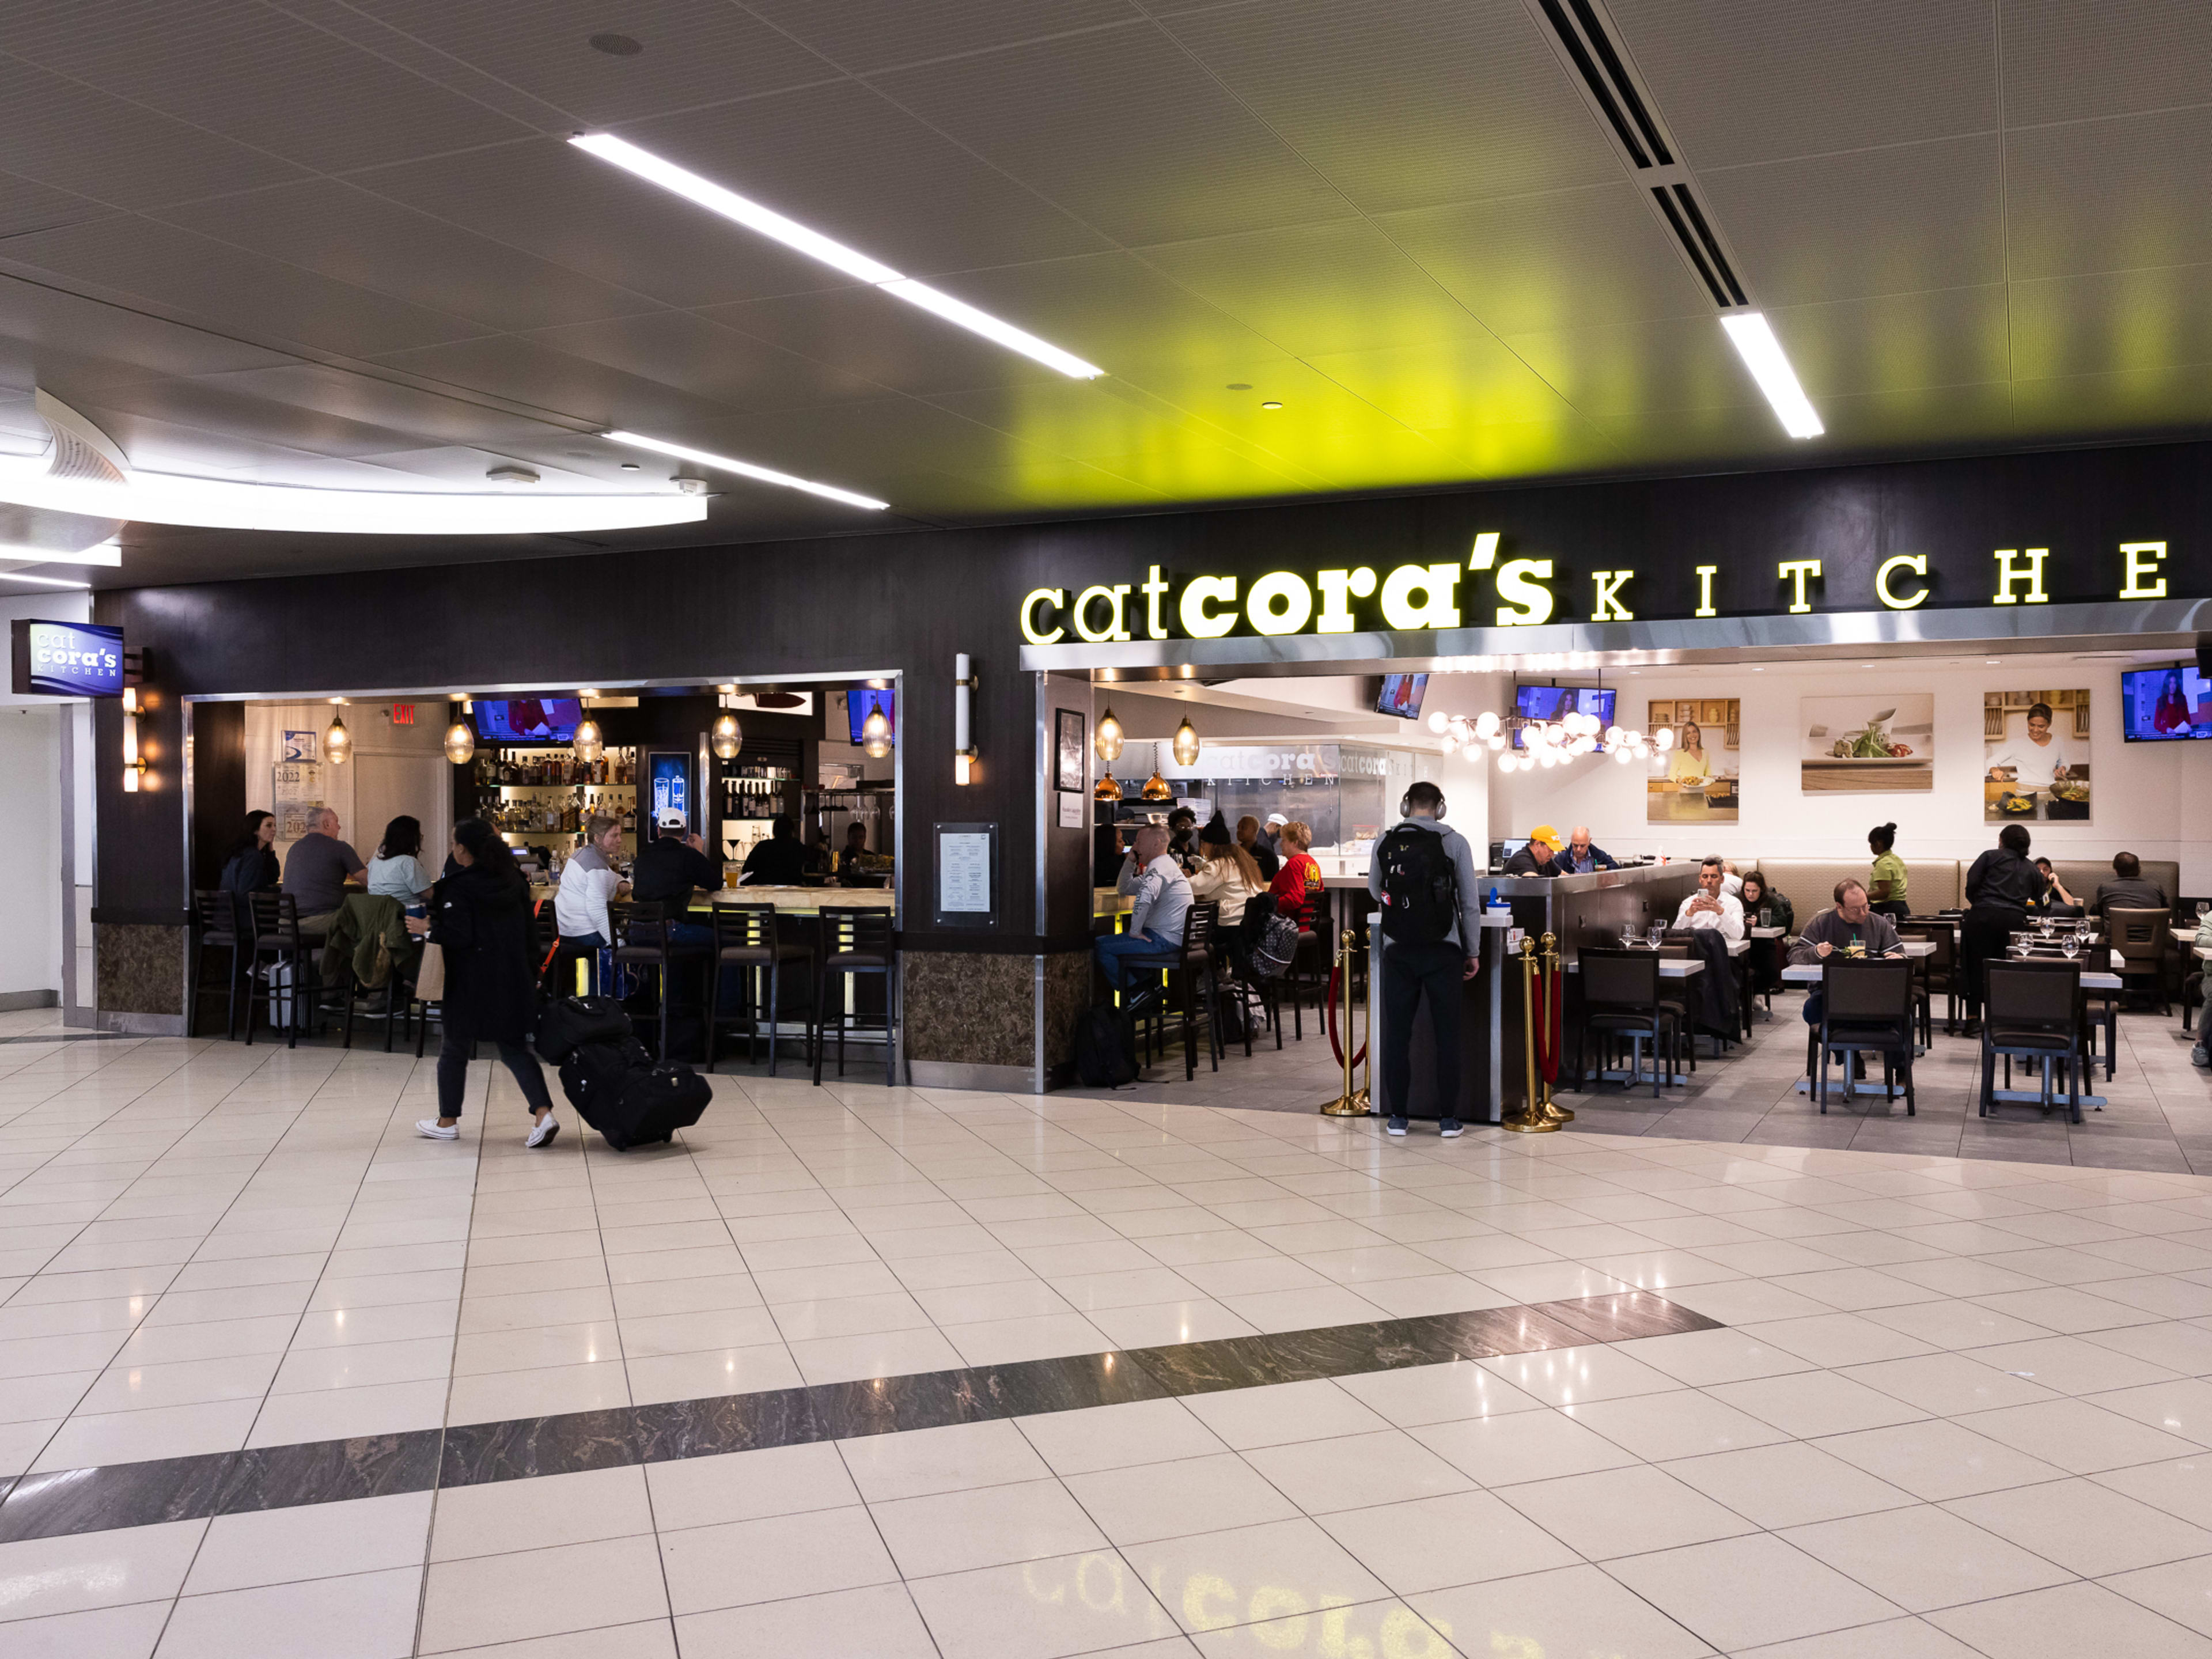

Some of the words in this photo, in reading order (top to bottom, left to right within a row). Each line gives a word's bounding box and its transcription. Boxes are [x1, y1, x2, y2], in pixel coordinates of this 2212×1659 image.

[1591, 541, 2167, 622] KITCHE
[36, 632, 75, 649] cat
[36, 648, 116, 668] cora's
[37, 664, 116, 677] KITCHEN
[393, 703, 415, 725] EXIT
[277, 772, 300, 782] 2022
[286, 821, 307, 833] 202
